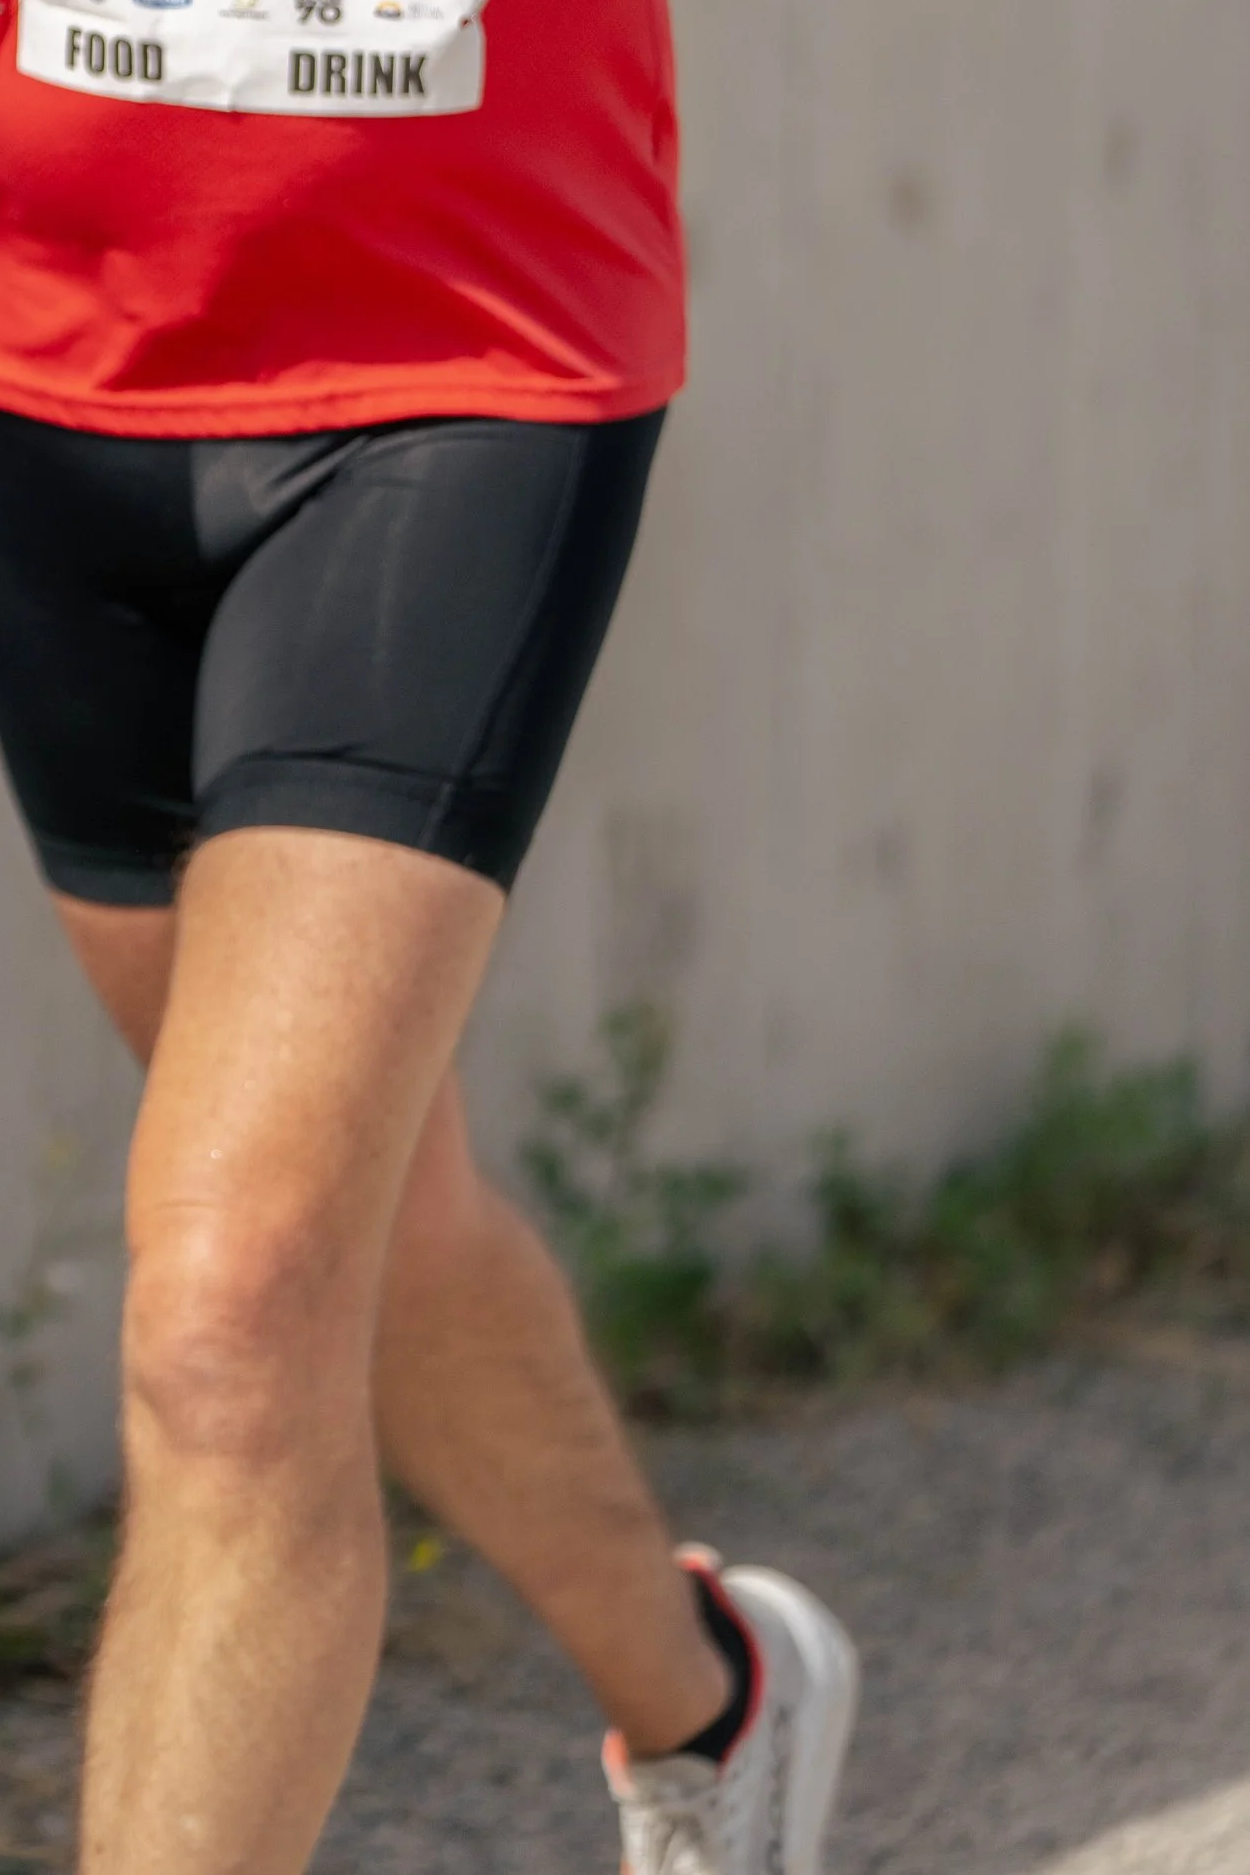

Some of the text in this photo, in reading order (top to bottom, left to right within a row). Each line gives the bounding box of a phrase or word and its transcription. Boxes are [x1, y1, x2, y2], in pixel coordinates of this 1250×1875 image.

[296, 1, 342, 25] 70
[65, 26, 429, 96] FOOD DRINK
